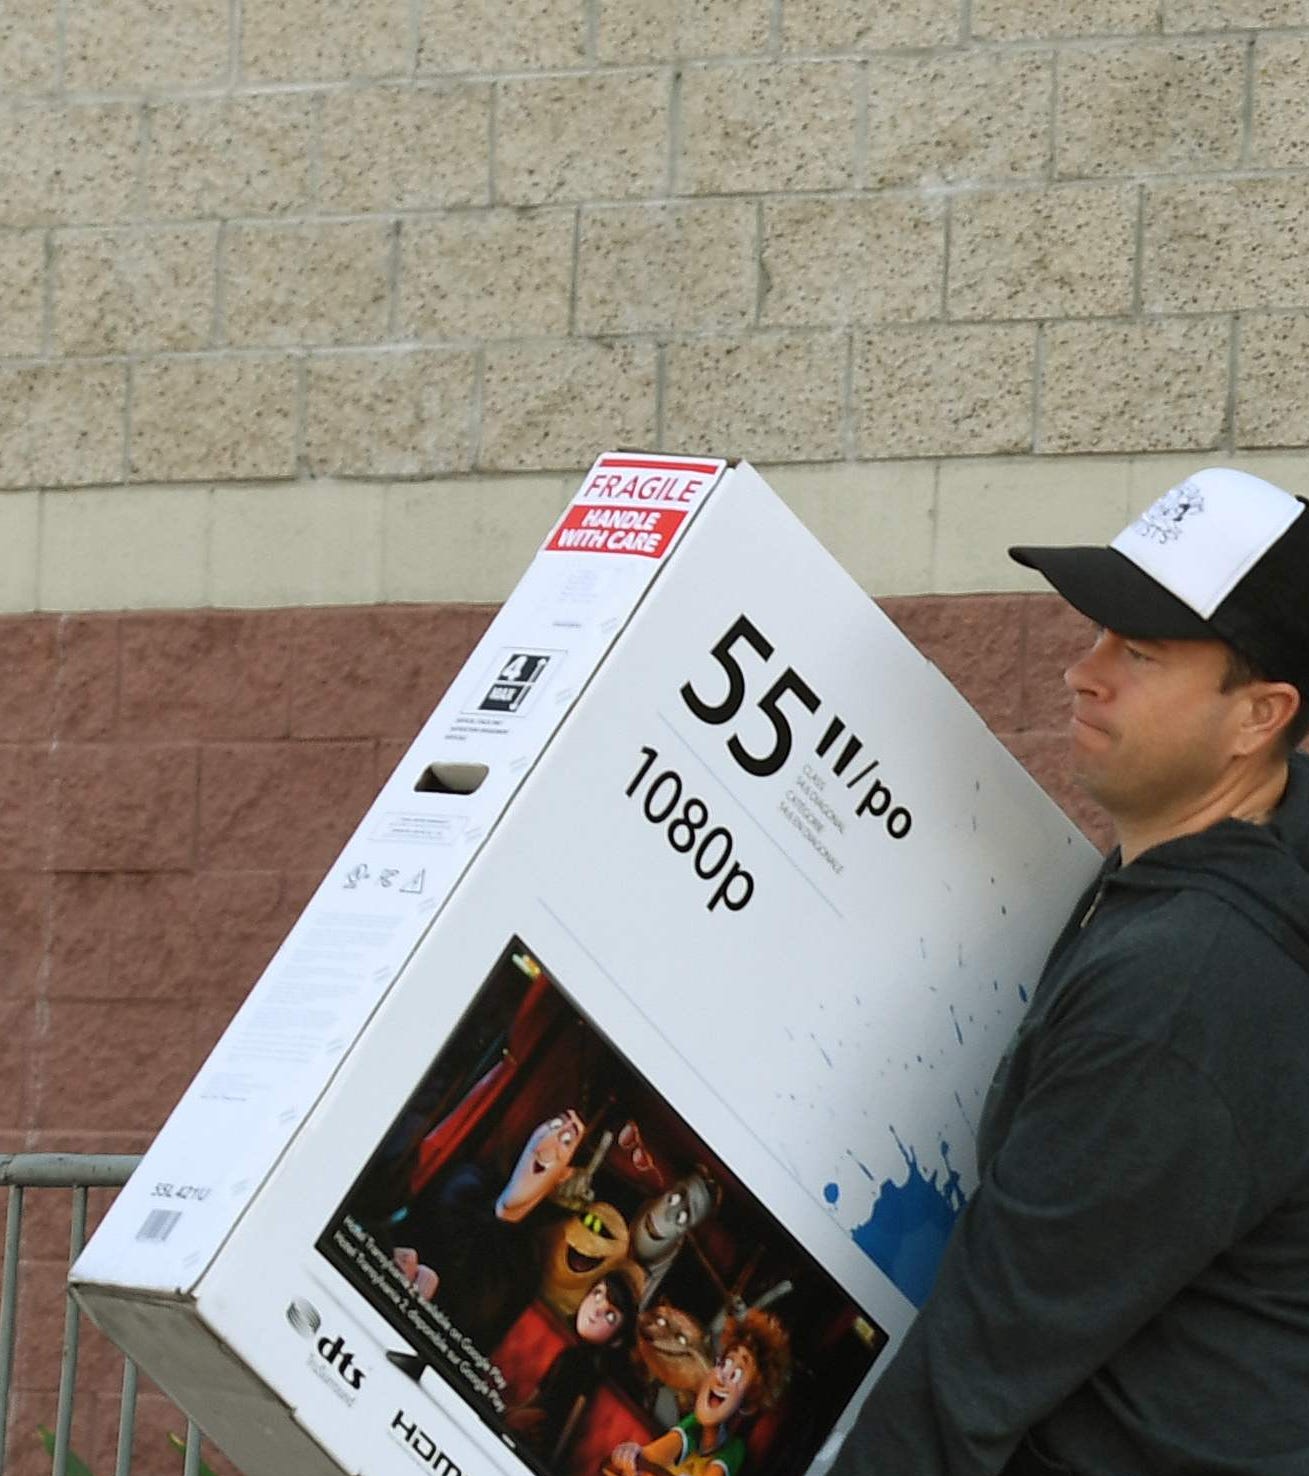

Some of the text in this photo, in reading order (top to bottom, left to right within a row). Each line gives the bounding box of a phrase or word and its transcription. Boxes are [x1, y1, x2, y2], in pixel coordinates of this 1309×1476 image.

[584, 475, 702, 503] FRAGILE
[582, 509, 661, 530] HANDLE
[558, 529, 662, 553] WITH CARE
[502, 655, 528, 681] 4
[625, 745, 755, 912] 1080p
[317, 1335, 366, 1390] dts
